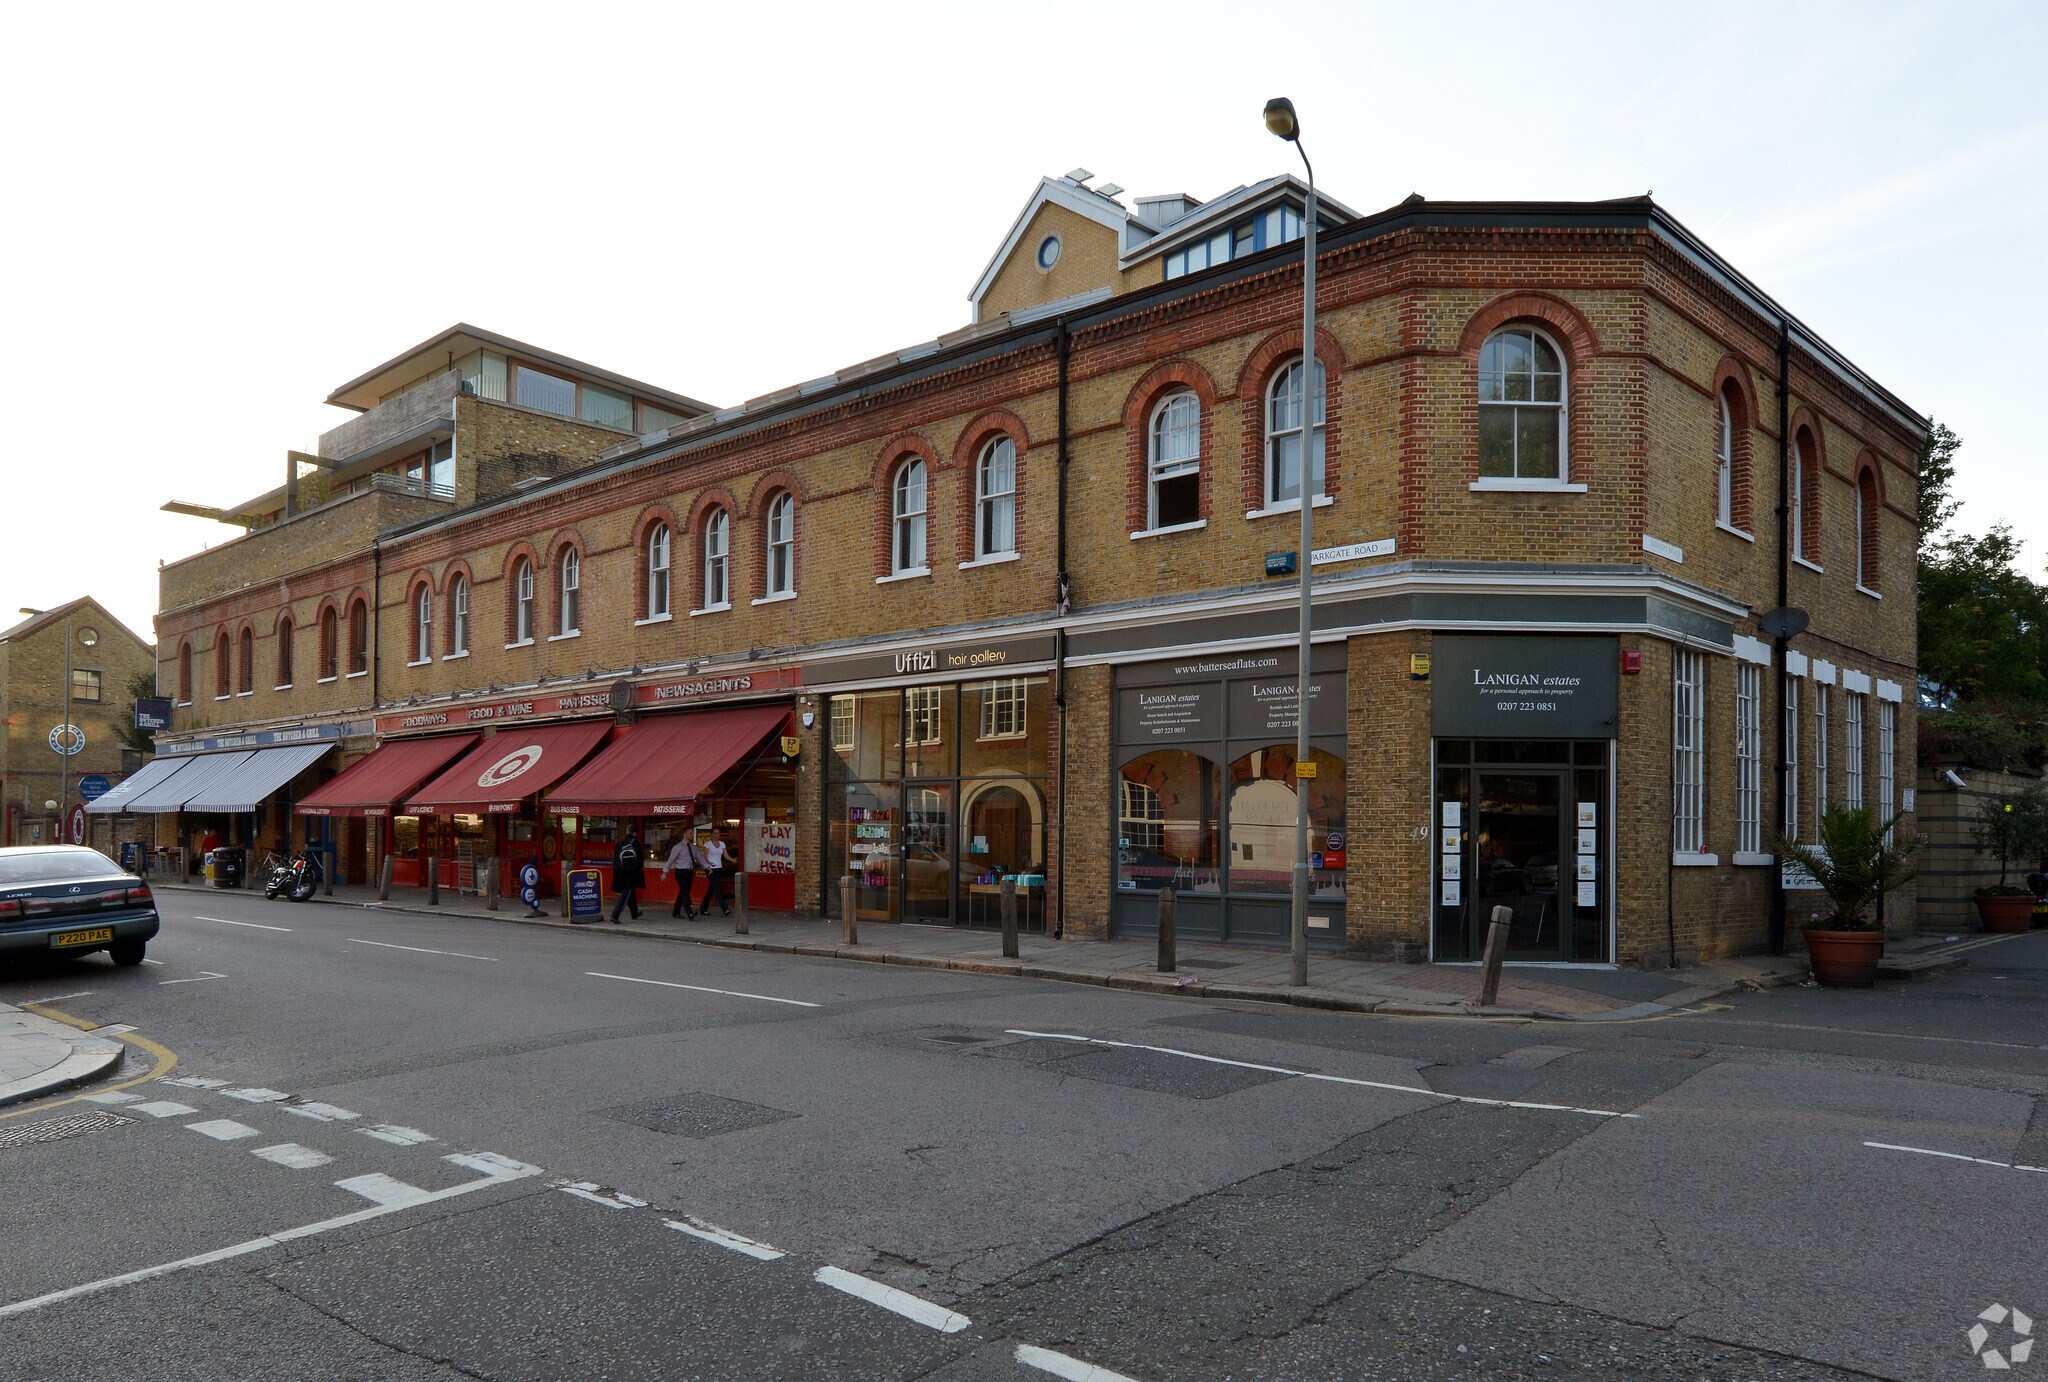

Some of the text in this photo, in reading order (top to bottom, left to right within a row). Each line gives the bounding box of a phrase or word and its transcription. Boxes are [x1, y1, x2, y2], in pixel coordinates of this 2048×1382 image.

[1354, 544, 1379, 556] ROAD
[895, 649, 1006, 673] Uffizi hair gallery
[1174, 657, 1278, 675] www.batterseaflats.com
[1474, 669, 1580, 686] LANIGAN estates
[654, 676, 752, 699] NEWSAGENTS
[1252, 685, 1295, 696] LANIGAN
[1140, 694, 1177, 704] LANIGAN
[1497, 702, 1556, 711] 0207 223 0851
[401, 714, 448, 728] FOODWAYS
[467, 707, 493, 720] FOOD
[496, 706, 504, 717] &
[508, 703, 533, 715] WINE
[274, 732, 282, 742] THE
[283, 730, 301, 741] BUTCHER
[306, 728, 320, 738] GRILL
[653, 805, 686, 814] PATISSERIE
[761, 826, 792, 839] PLAY
[1410, 826, 1428, 840] 49
[760, 860, 792, 873] HERE
[58, 930, 109, 944] P220 PAE
